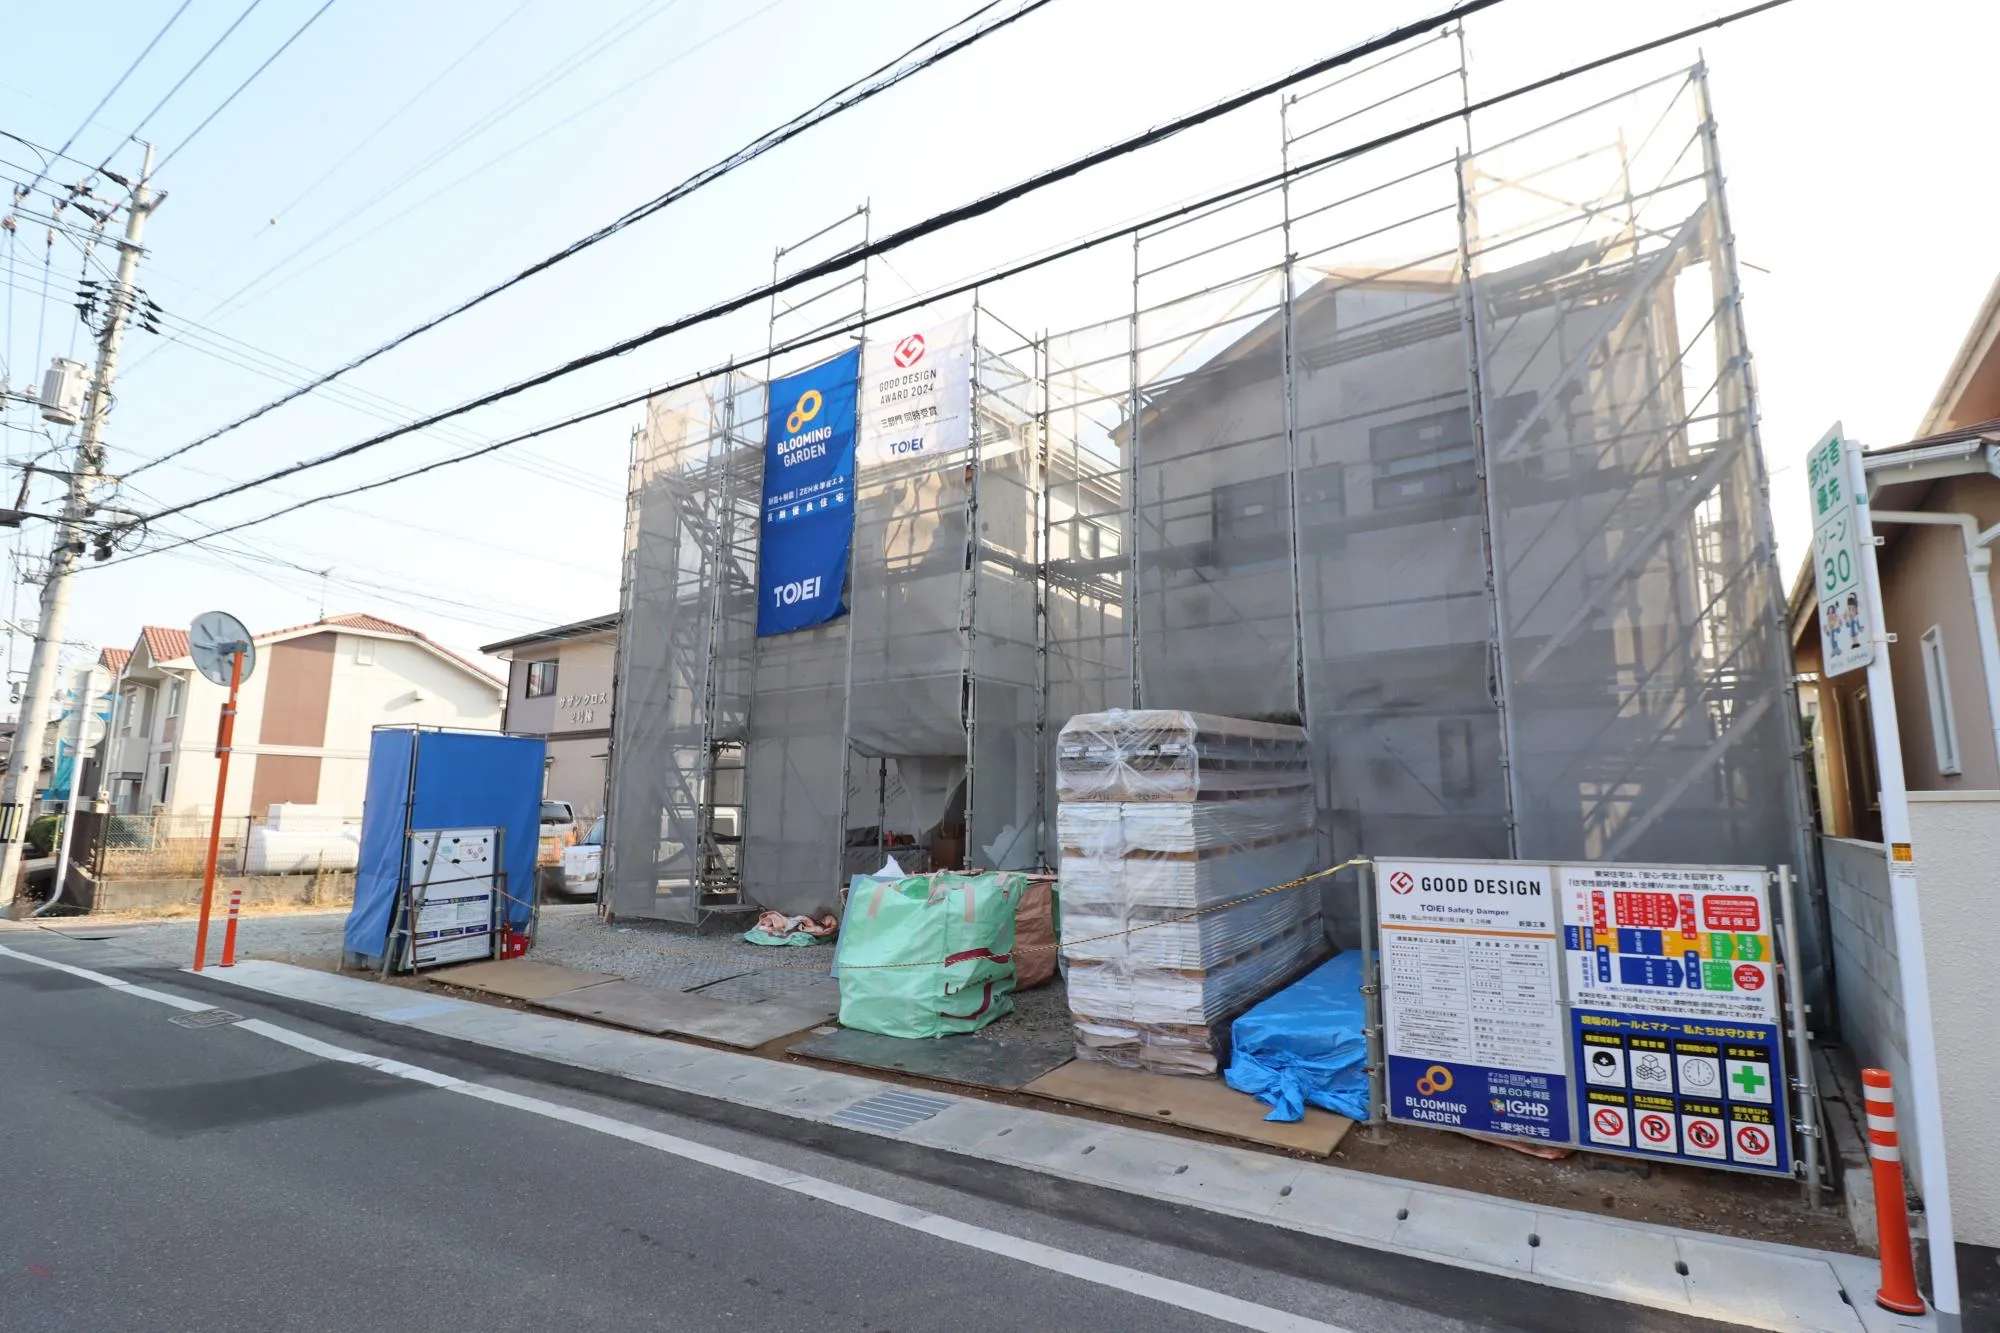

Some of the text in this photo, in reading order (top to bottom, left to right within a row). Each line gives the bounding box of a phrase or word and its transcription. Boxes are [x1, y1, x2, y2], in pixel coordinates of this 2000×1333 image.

[879, 369, 937, 392] GOOD DESIGN
[880, 383, 934, 405] AWARD 2024
[777, 426, 832, 455] BLOOMING
[784, 442, 826, 468] GARDEN
[1809, 437, 1841, 488] 歩行者
[1817, 477, 1841, 515] 優先
[1818, 518, 1847, 555] ゾーン
[1824, 549, 1850, 591] 30
[774, 576, 822, 608] TOEI
[560, 691, 608, 709] サザンクロス
[1421, 876, 1541, 896] GOOD DESIGN
[1420, 904, 1509, 916] TOEI Safety Damper
[1580, 1015, 1767, 1040] 現場のルールとマナー 私たちは守ります
[1405, 1095, 1468, 1114] BLOOMING
[1505, 1099, 1549, 1117] IGHD
[1412, 1108, 1462, 1125] GARDEN
[1734, 1113, 1770, 1124] 立入禁止
[1500, 1121, 1550, 1138] 東栄住宅
